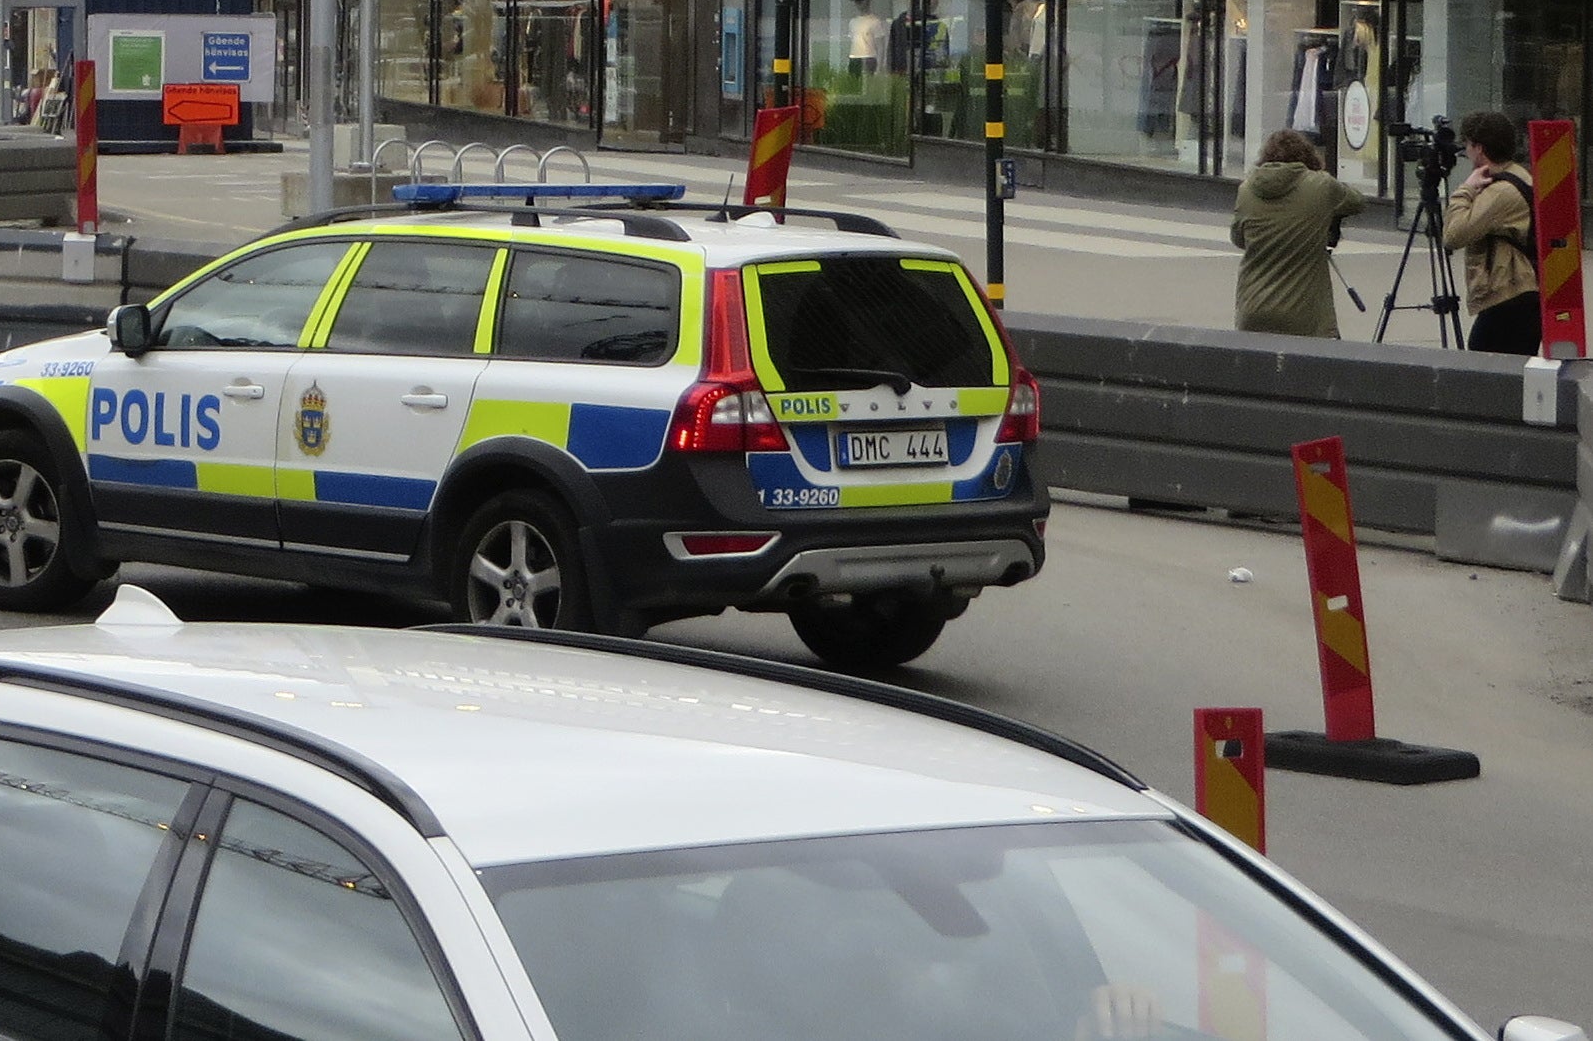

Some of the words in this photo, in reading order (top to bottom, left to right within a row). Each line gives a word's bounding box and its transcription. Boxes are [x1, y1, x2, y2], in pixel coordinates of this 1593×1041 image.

[208, 36, 246, 46] Gående
[205, 47, 249, 57] hänvisas
[41, 361, 95, 377] 33-9260
[780, 397, 832, 415] POLIS
[838, 400, 957, 413] VOLVO
[91, 387, 221, 451] POLIS
[851, 435, 891, 461] DMC
[906, 430, 945, 458] 444
[772, 488, 840, 506] 33-9260
